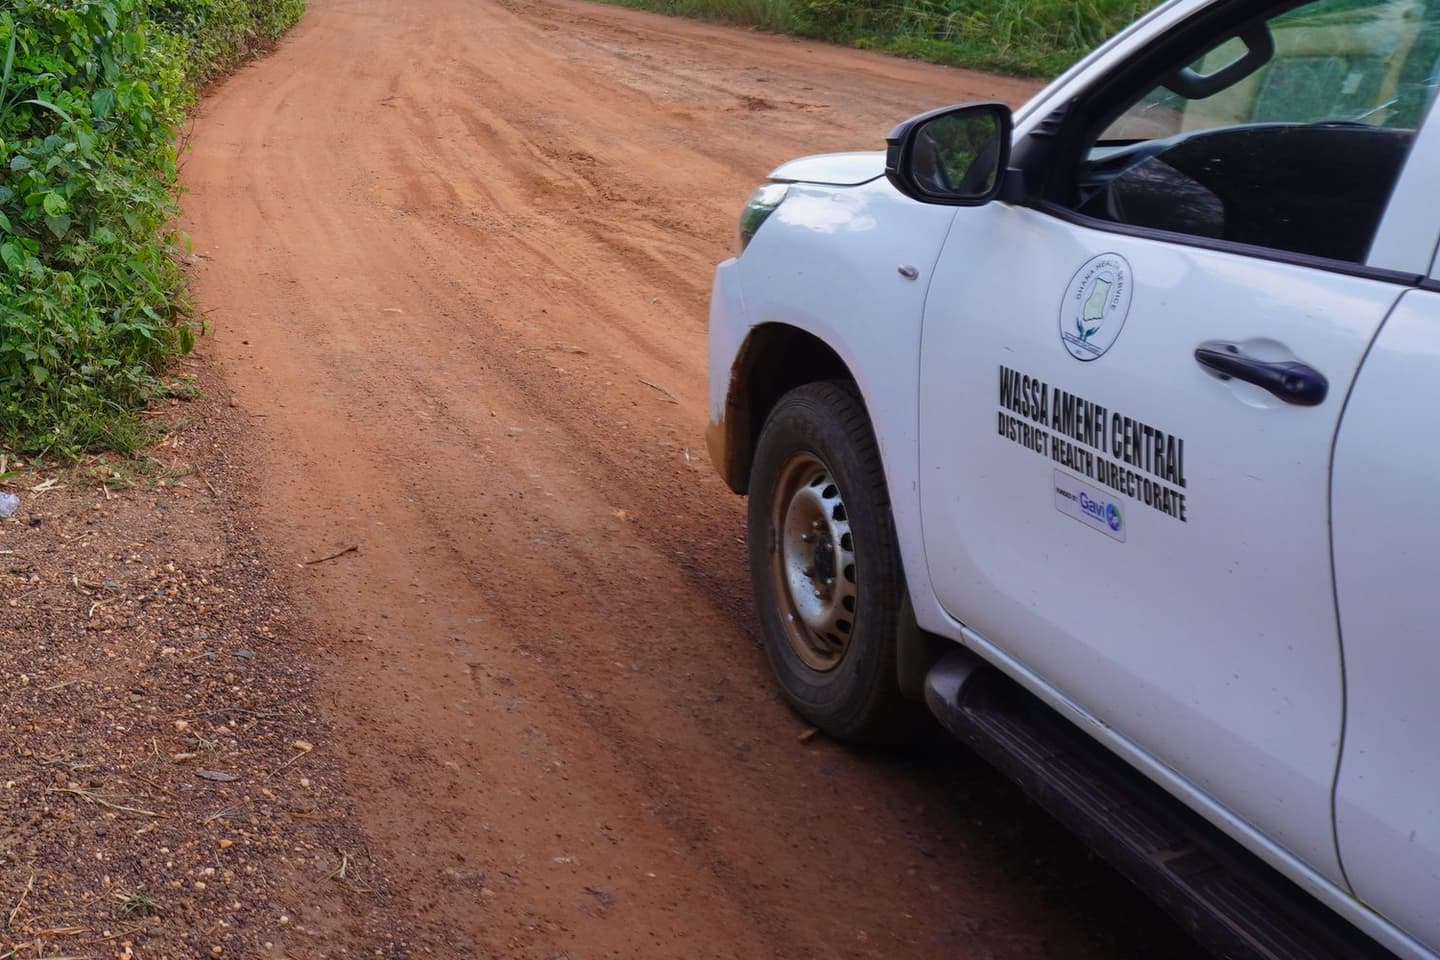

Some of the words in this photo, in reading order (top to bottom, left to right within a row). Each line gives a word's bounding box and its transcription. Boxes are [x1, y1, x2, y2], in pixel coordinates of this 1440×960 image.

[998, 411, 1049, 457] DISTRICT
[1052, 435, 1094, 479] HEALTH
[1097, 456, 1187, 523] DIRECTORATE
[999, 365, 1049, 428] WASSA
[1052, 387, 1108, 453] AMENFI
[1112, 411, 1187, 489] CENTRAL
[1079, 491, 1105, 518] Gavi
